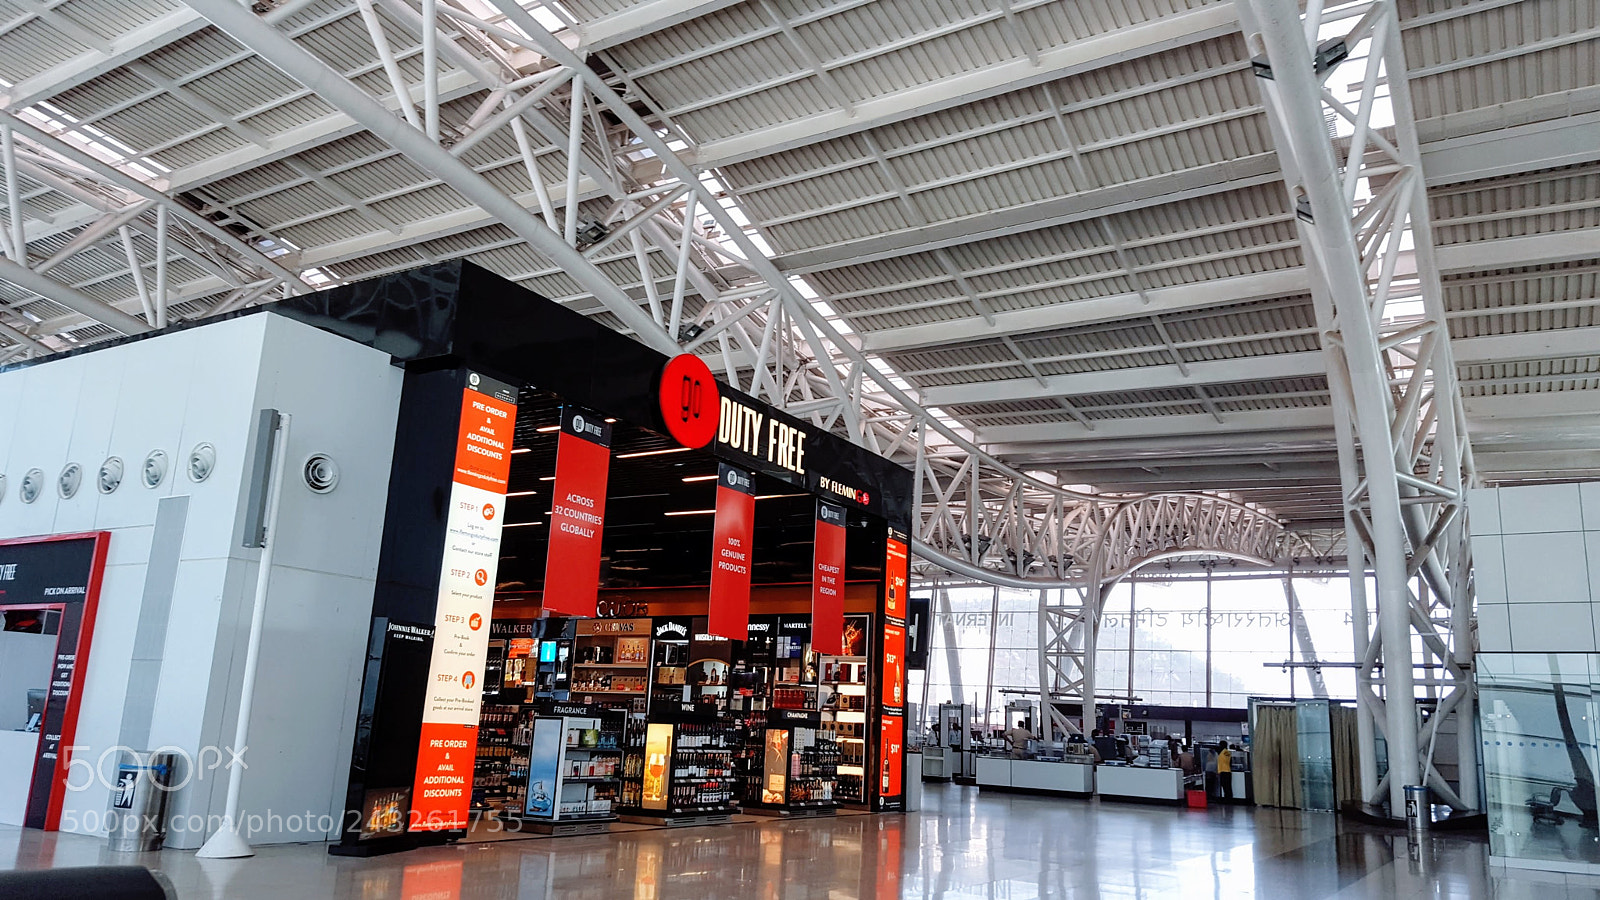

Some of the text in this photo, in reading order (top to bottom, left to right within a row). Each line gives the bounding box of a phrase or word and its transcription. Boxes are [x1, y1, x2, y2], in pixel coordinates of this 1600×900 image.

[681, 375, 702, 422] go
[472, 401, 507, 418] PRE ORDER
[479, 426, 495, 436] AVAIL
[718, 396, 806, 474] DUTY FREE
[467, 432, 505, 450] ADDITIONAL
[467, 444, 502, 460] DISCOUNTS
[820, 476, 870, 506] BY FLEMINGO
[566, 493, 594, 508] ACROSS
[460, 502, 474, 511] STEP
[555, 505, 602, 525] 32 COUNTRIES
[560, 522, 595, 538] GLOBALLY
[728, 538, 740, 547] 100%
[721, 548, 745, 561] GENUINE
[3, 564, 17, 580] FREE
[718, 561, 746, 574] PRODUCTS
[819, 563, 840, 574] CHEAPEST
[450, 569, 466, 578] STEP
[827, 576, 835, 584] THE
[44, 586, 86, 596] PICK ON ARRIVAL
[820, 587, 836, 596] REGION
[445, 614, 460, 623] STEP
[387, 622, 432, 636] JOHNNIE WALKER
[492, 623, 532, 633] WALKER
[656, 622, 669, 637] JACK
[668, 622, 687, 637] DANIEL'S
[437, 674, 452, 682] STEP
[554, 706, 587, 715] FRAGRANCE
[444, 740, 467, 748] ORDER
[424, 776, 465, 784] ADDITIONAL
[424, 789, 462, 798] DISCOUNTS
